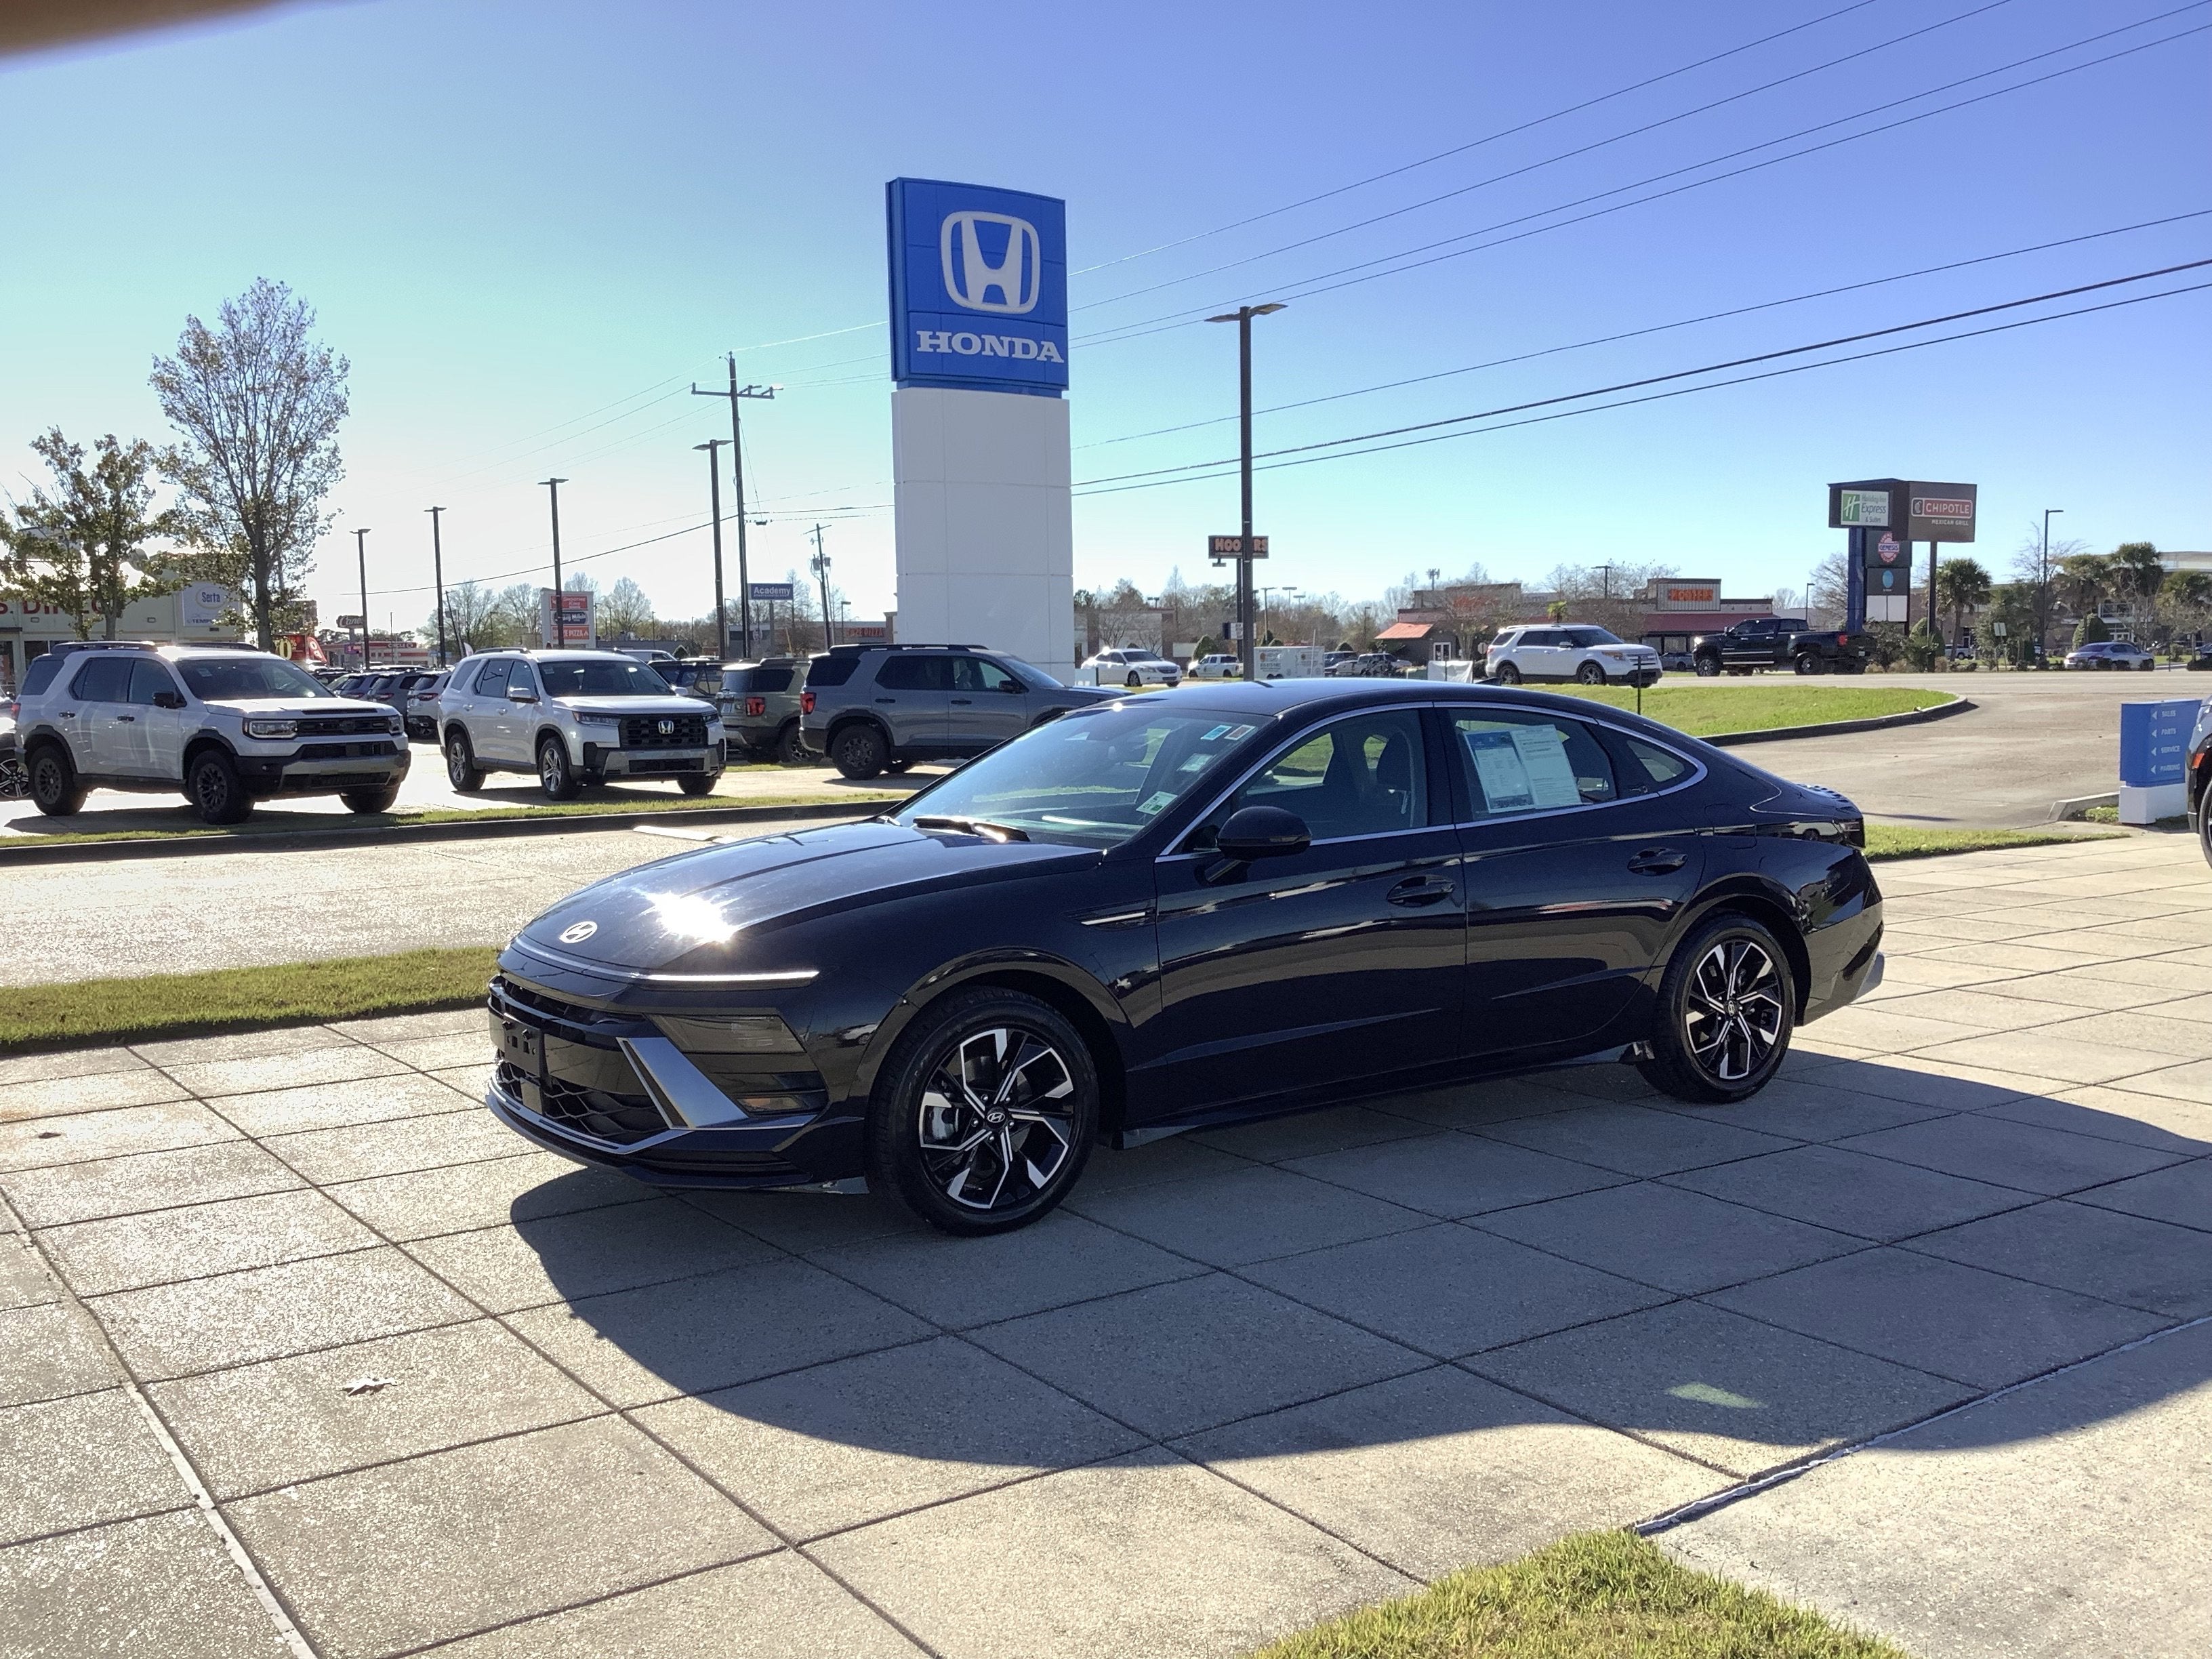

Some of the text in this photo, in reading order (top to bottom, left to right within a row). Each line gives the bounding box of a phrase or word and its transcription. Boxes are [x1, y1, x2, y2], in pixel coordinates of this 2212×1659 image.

[916, 329, 1064, 363] HONDA
[1862, 503, 1886, 515] Express
[1925, 503, 1969, 514] CHIPOTLE
[1215, 538, 1267, 552] HOORS
[202, 592, 221, 602] Serta
[754, 587, 790, 596] Academy
